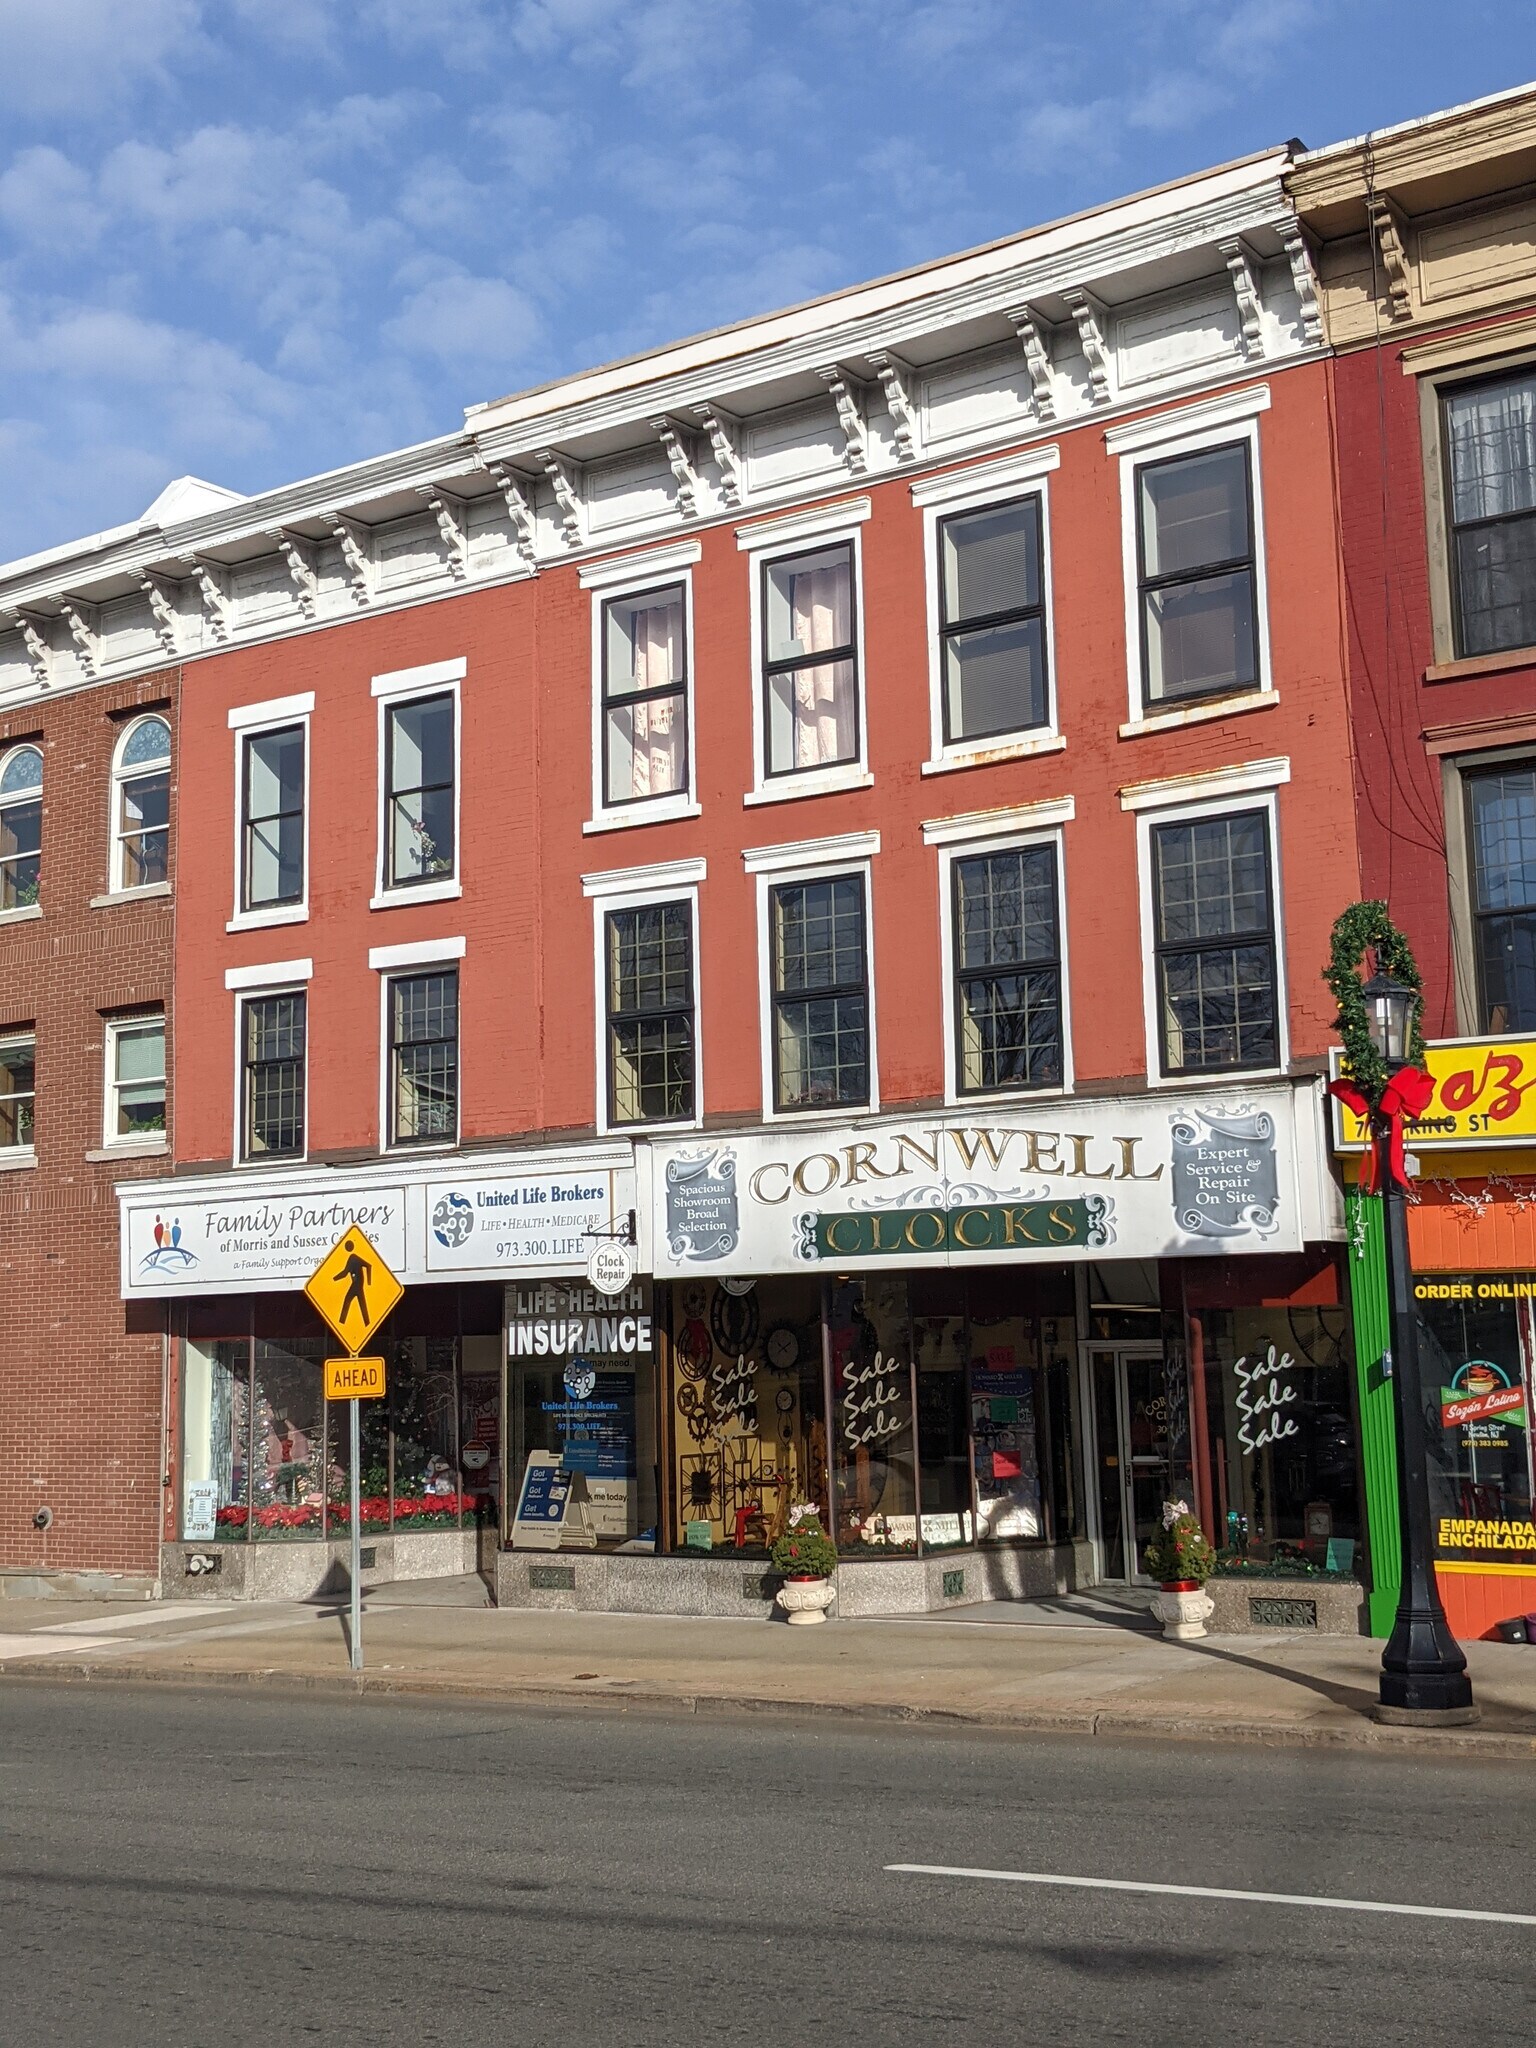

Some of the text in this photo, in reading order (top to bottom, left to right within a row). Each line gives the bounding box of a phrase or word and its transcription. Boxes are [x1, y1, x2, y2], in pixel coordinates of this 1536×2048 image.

[1469, 1114, 1490, 1131] ST
[1197, 1147, 1249, 1160] Expert
[748, 1127, 1165, 1206] CORNWELL
[1186, 1160, 1261, 1175] Service &
[680, 1184, 725, 1196] Spacious
[1198, 1176, 1251, 1190] Repair
[477, 1184, 604, 1207] United Life Brokers
[674, 1197, 731, 1207] Showroom
[1196, 1190, 1256, 1205] On Site
[206, 1203, 394, 1238] Family Partners
[551, 1214, 600, 1227] MEDICARE
[687, 1208, 719, 1219] Broad
[679, 1221, 727, 1232] Selection
[825, 1203, 1078, 1253] CLOCKS
[220, 1230, 380, 1253] of Morris and Sussex Cies
[496, 1238, 584, 1258] 973.300.LIFE
[233, 1262, 240, 1270] a
[242, 1257, 270, 1270] Family
[271, 1256, 303, 1270] Support
[597, 1255, 625, 1267] Clock
[596, 1268, 625, 1281] Repair
[517, 1287, 643, 1314] LIFE HEALTH
[1414, 1284, 1473, 1299] ORDER
[508, 1316, 652, 1355] INSURANCE
[712, 1353, 758, 1392] Sale
[842, 1350, 900, 1391] Sale
[1234, 1345, 1295, 1388] Sale
[334, 1368, 378, 1388] AHEAD
[542, 1401, 618, 1410] United Life Brokers
[711, 1382, 759, 1420] Sale
[843, 1380, 901, 1420] Sale
[1235, 1378, 1297, 1422] Sale
[844, 1409, 902, 1450] Sale
[1237, 1411, 1299, 1455] Sale
[607, 1493, 629, 1502] today.
